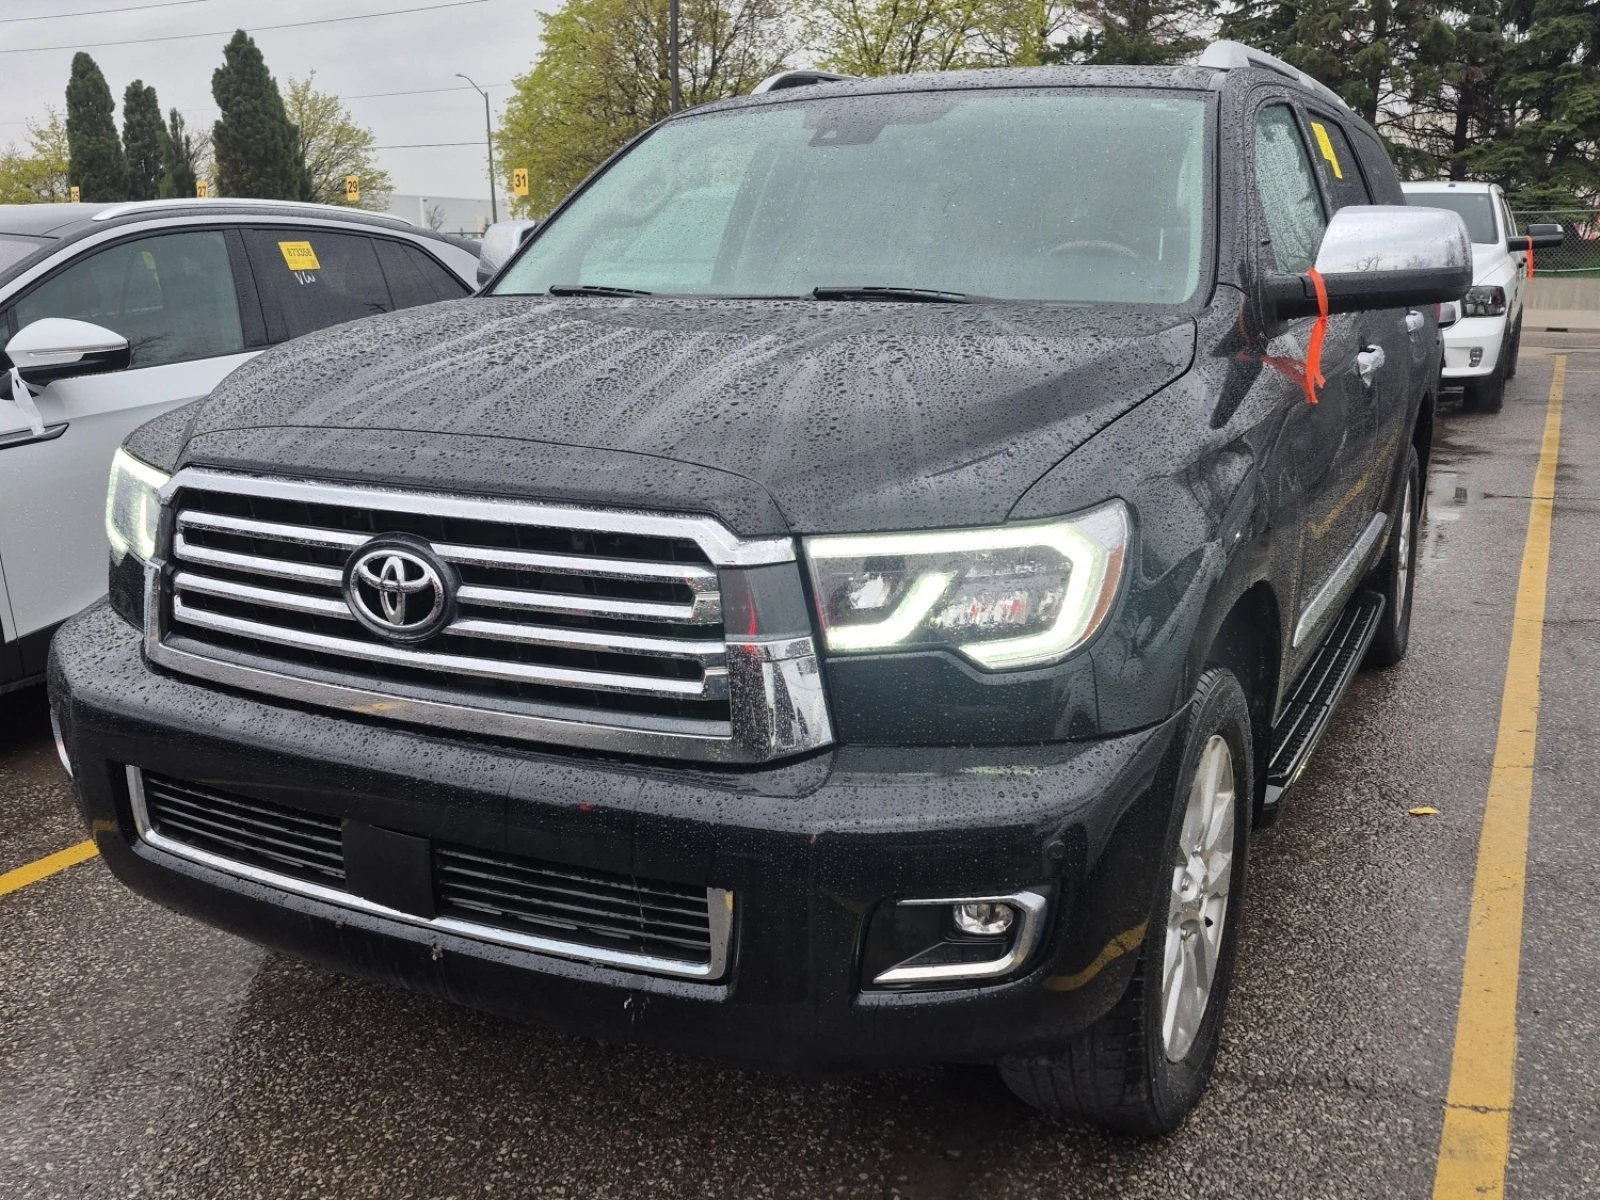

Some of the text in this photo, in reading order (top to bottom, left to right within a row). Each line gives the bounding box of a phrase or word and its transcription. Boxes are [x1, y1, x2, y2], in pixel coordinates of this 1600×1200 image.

[348, 180, 358, 193] 29
[515, 173, 526, 188] 31
[198, 186, 206, 198] 27
